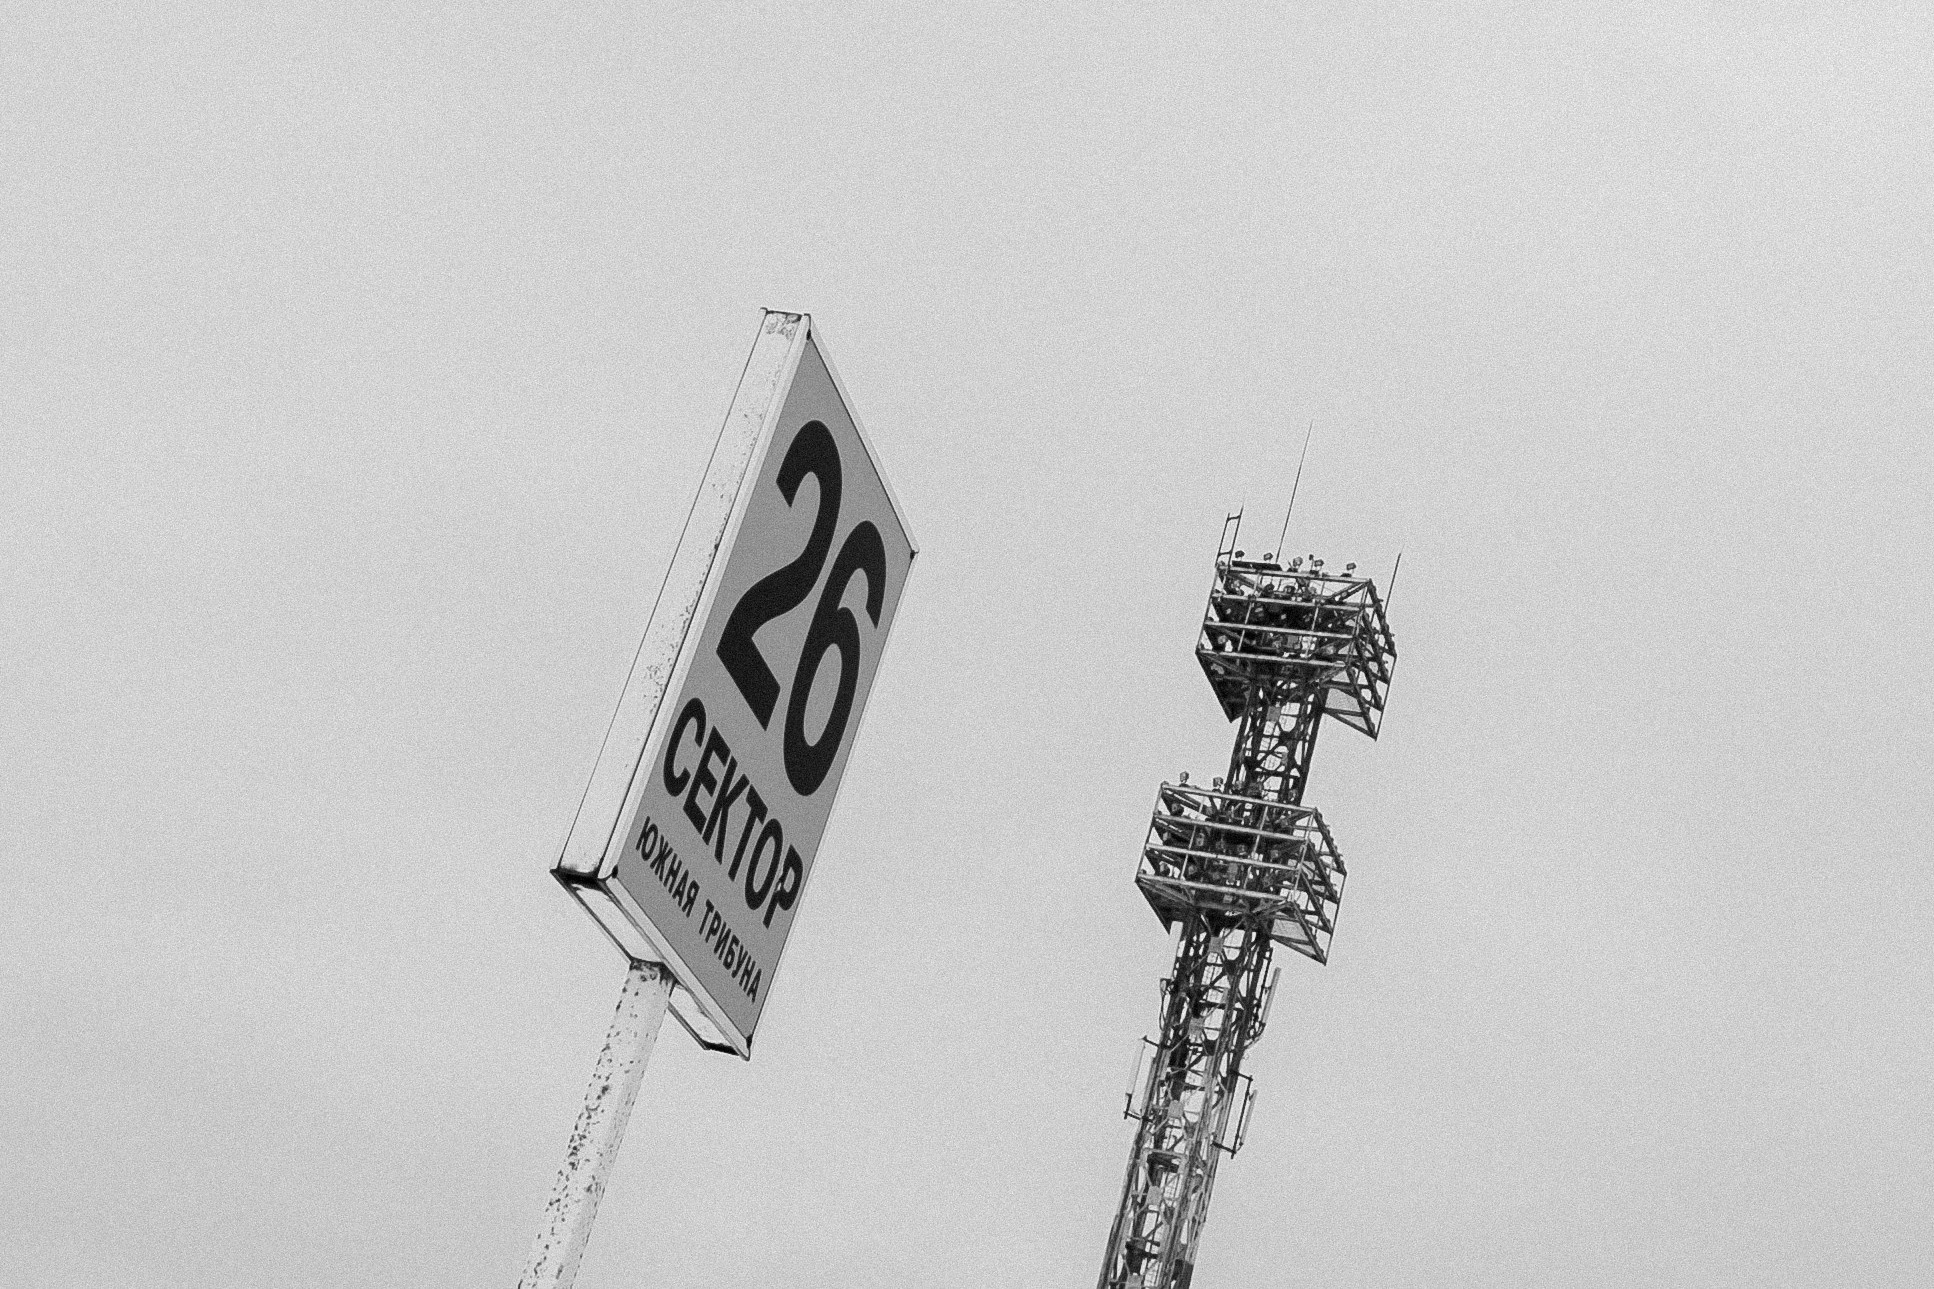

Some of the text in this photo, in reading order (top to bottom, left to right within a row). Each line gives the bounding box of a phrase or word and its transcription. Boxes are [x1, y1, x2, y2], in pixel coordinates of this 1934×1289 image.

[716, 420, 887, 797] 26
[636, 816, 763, 1003] ЮЖНАЯ ТРИБУНА
[663, 697, 804, 929] СЕКТОР
